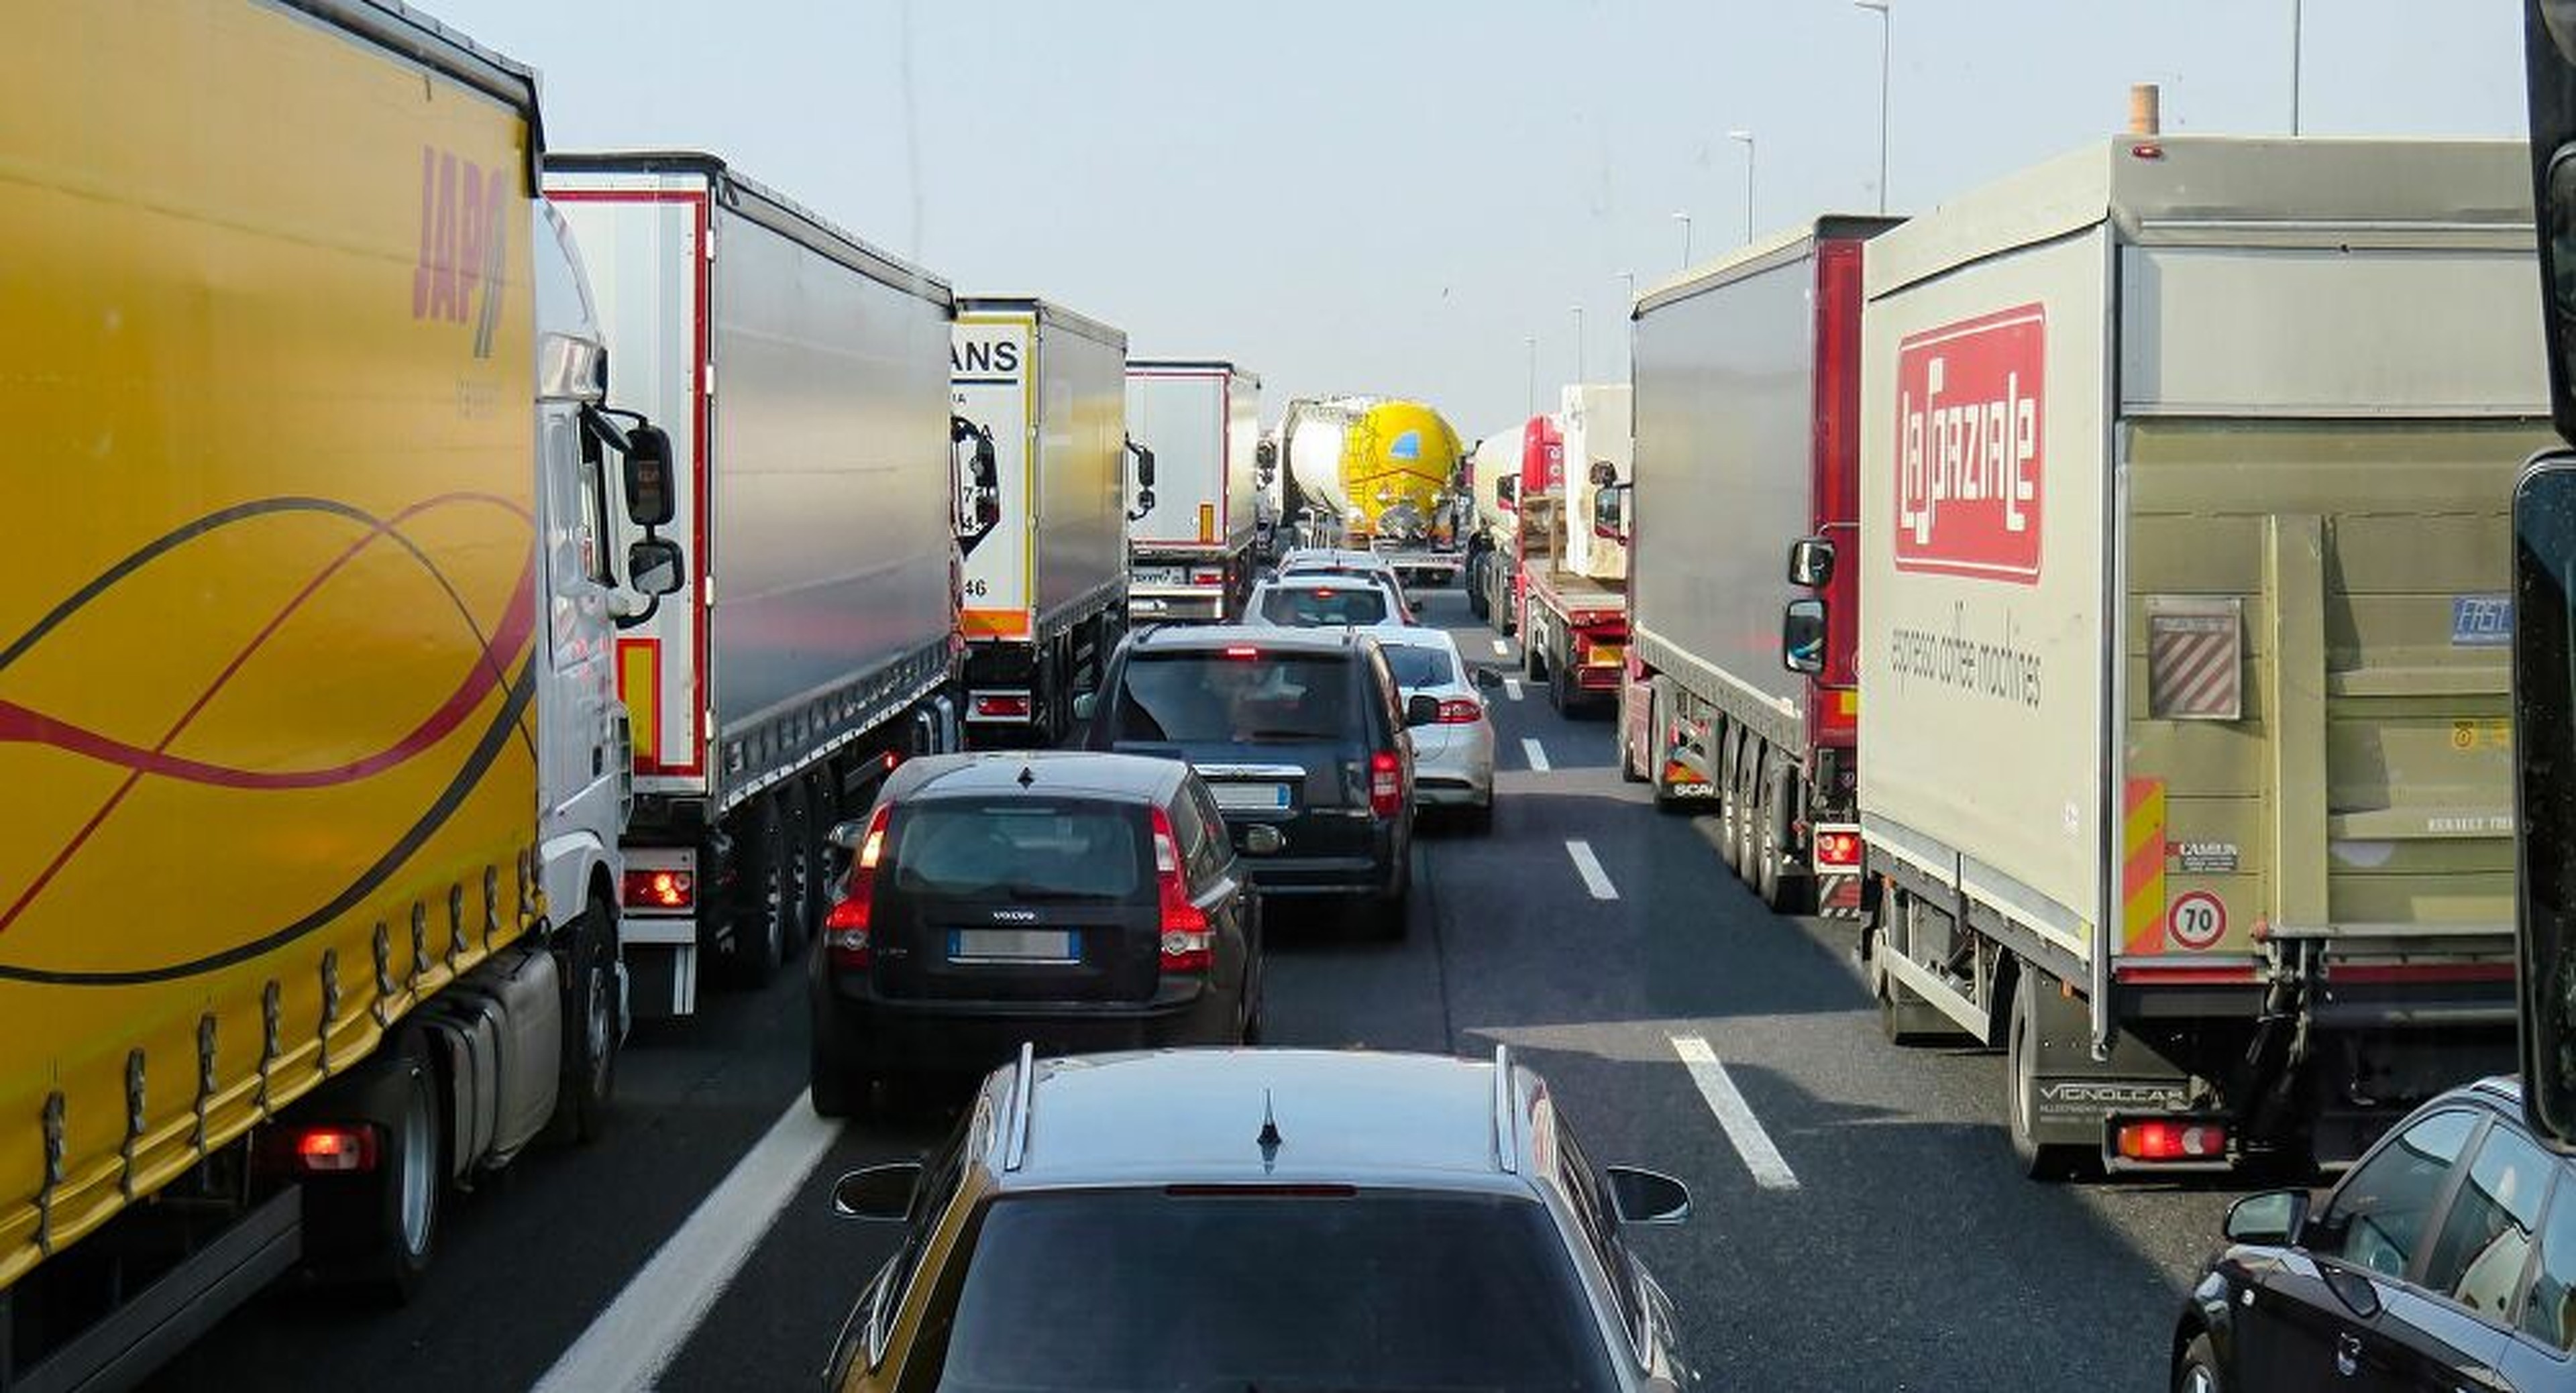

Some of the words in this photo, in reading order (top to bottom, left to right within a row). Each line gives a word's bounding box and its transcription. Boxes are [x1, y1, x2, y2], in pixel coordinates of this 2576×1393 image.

[1939, 600, 1976, 689] coffee
[1980, 606, 2042, 711] machines
[2185, 908, 2212, 932] 70
